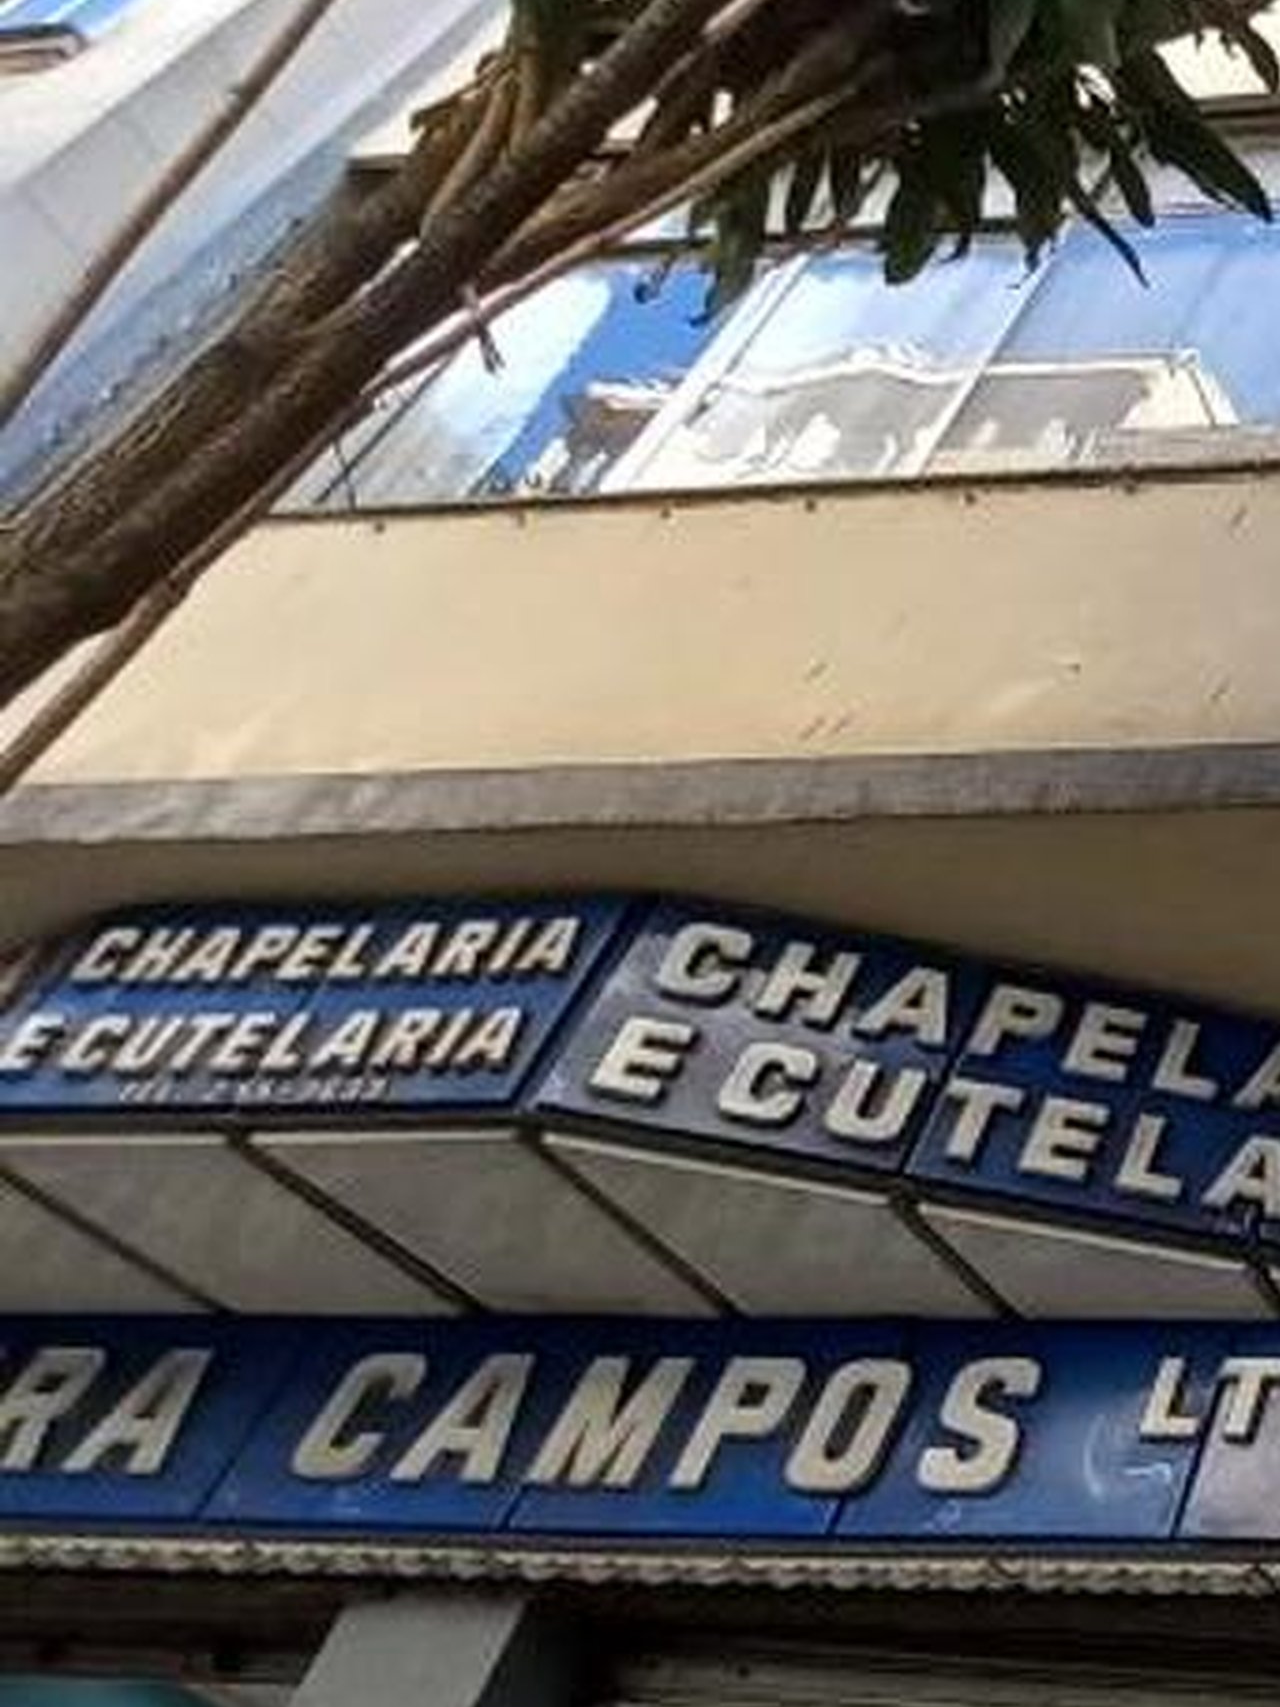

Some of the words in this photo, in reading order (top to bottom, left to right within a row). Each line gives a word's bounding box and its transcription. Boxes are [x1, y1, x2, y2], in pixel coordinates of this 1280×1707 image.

[70, 916, 581, 981] CHAPELARIA
[0, 1011, 64, 1070] E
[60, 1006, 523, 1071] CUTELARIA
[588, 1016, 694, 1100] E
[291, 1352, 1041, 1494] CAMPOS
